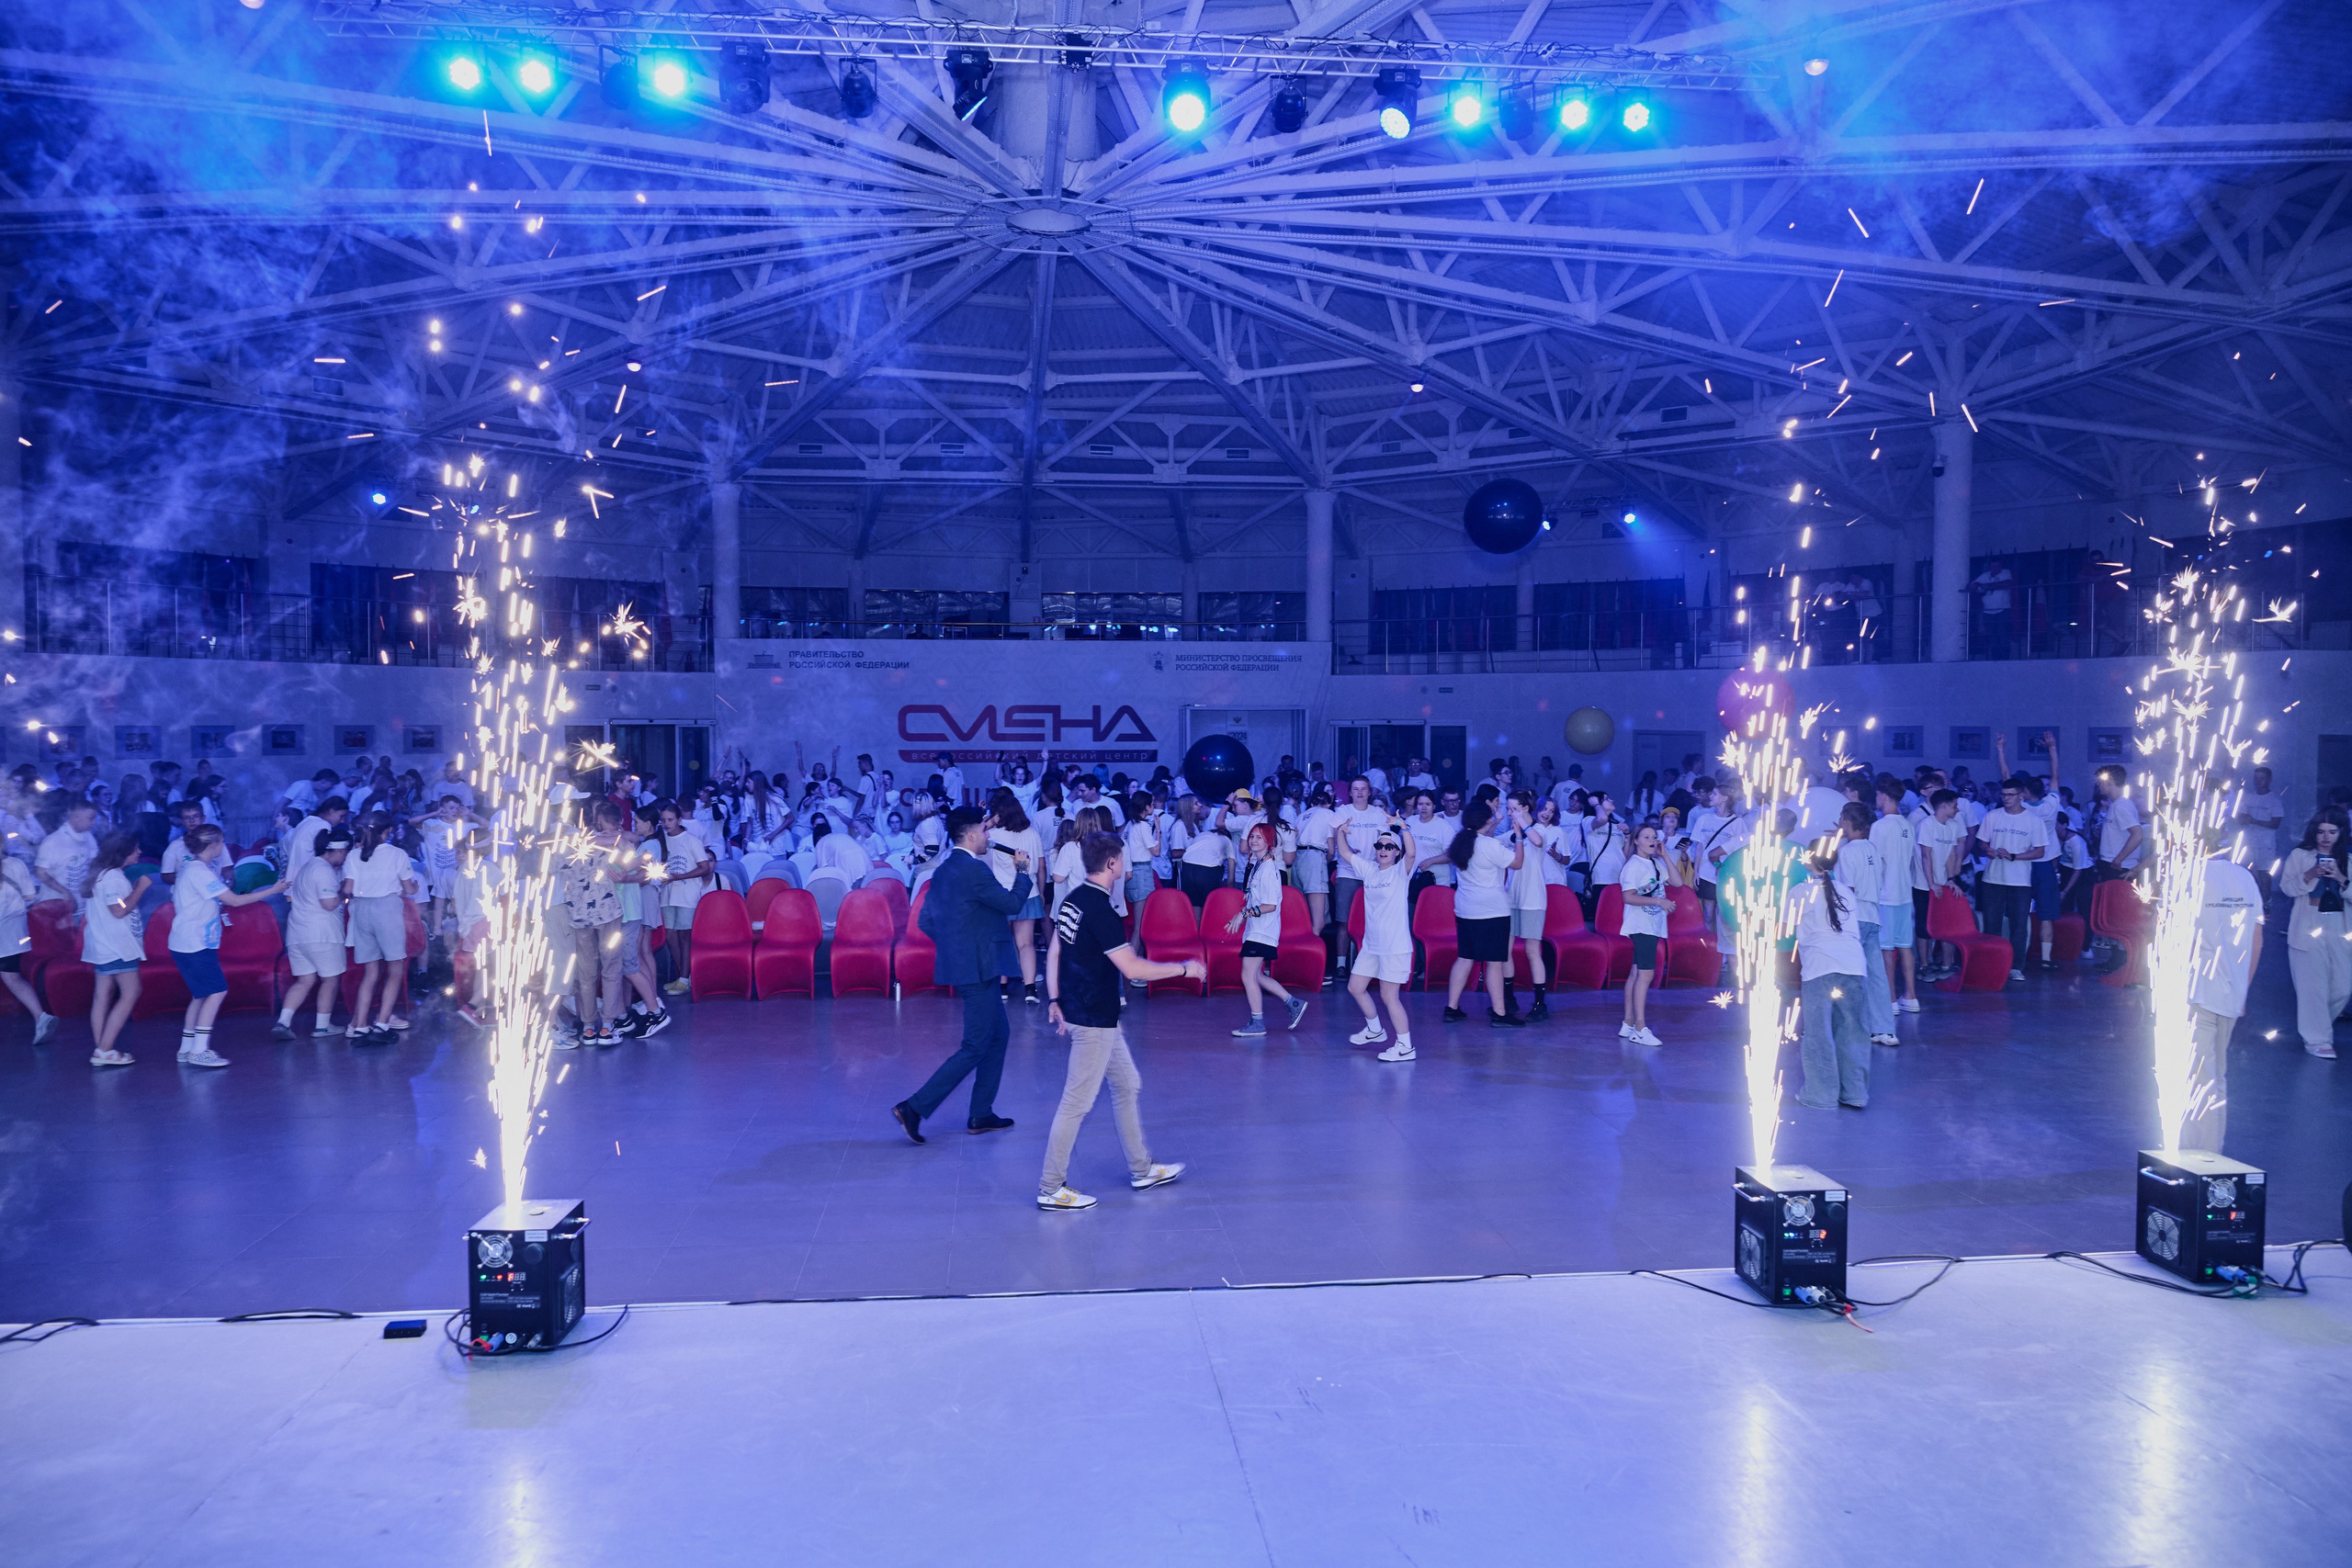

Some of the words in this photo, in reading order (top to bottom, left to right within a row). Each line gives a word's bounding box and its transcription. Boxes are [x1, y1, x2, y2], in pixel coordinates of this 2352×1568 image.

[788, 650, 865, 659] ПРАВИТЕЛЬСТВО
[1175, 654, 1240, 663] МИНИСТЕРСТВО
[1241, 654, 1303, 663] ПРОСВЕЩЕНИЯ
[788, 660, 851, 670] РОССИЙСКОЙ
[854, 660, 910, 670] ФЕДЕРАЦИИ
[1175, 662, 1229, 671] РОССИЙСКОЙ
[1230, 663, 1280, 671] ФЕДЕРАЦИИ
[898, 705, 1158, 741] СМЕНА
[1105, 751, 1148, 762] центр
